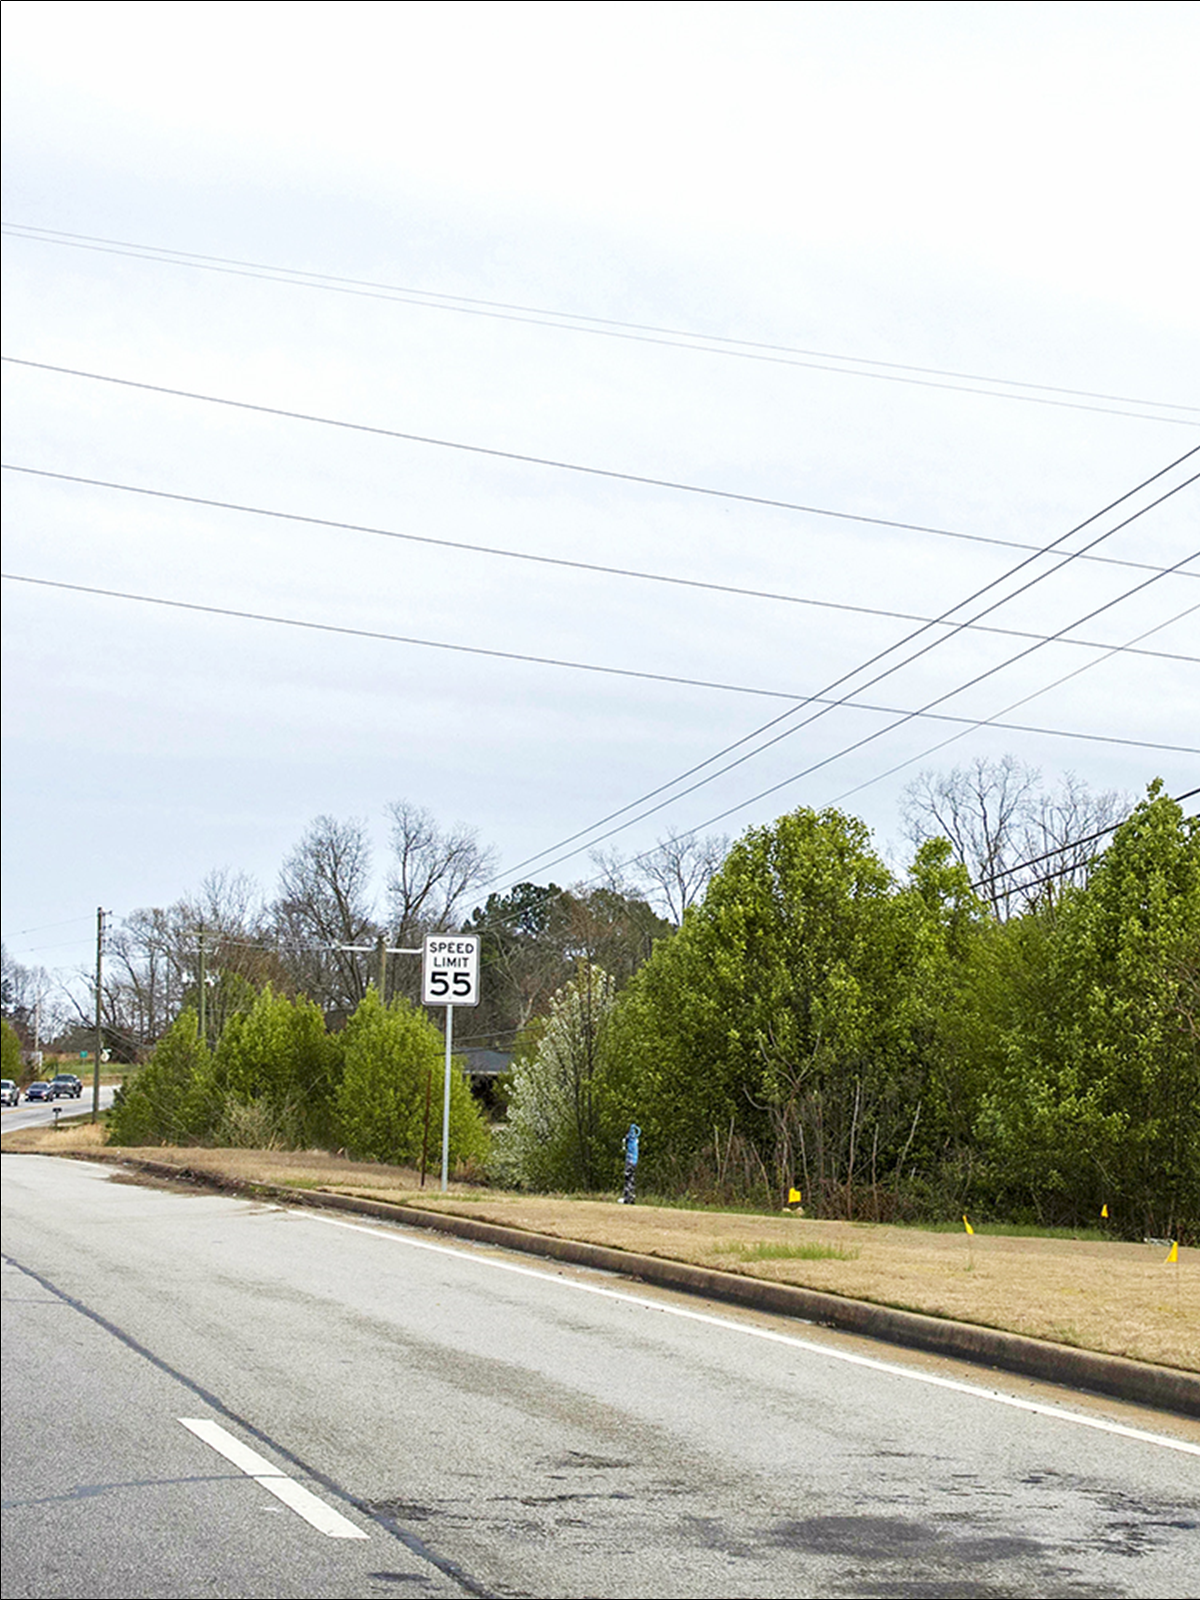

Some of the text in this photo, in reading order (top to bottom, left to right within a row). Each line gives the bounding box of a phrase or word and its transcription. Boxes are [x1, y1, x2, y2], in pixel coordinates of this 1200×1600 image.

[429, 941, 474, 954] SPEED
[433, 957, 469, 967] LIMIT
[430, 971, 471, 996] 55
